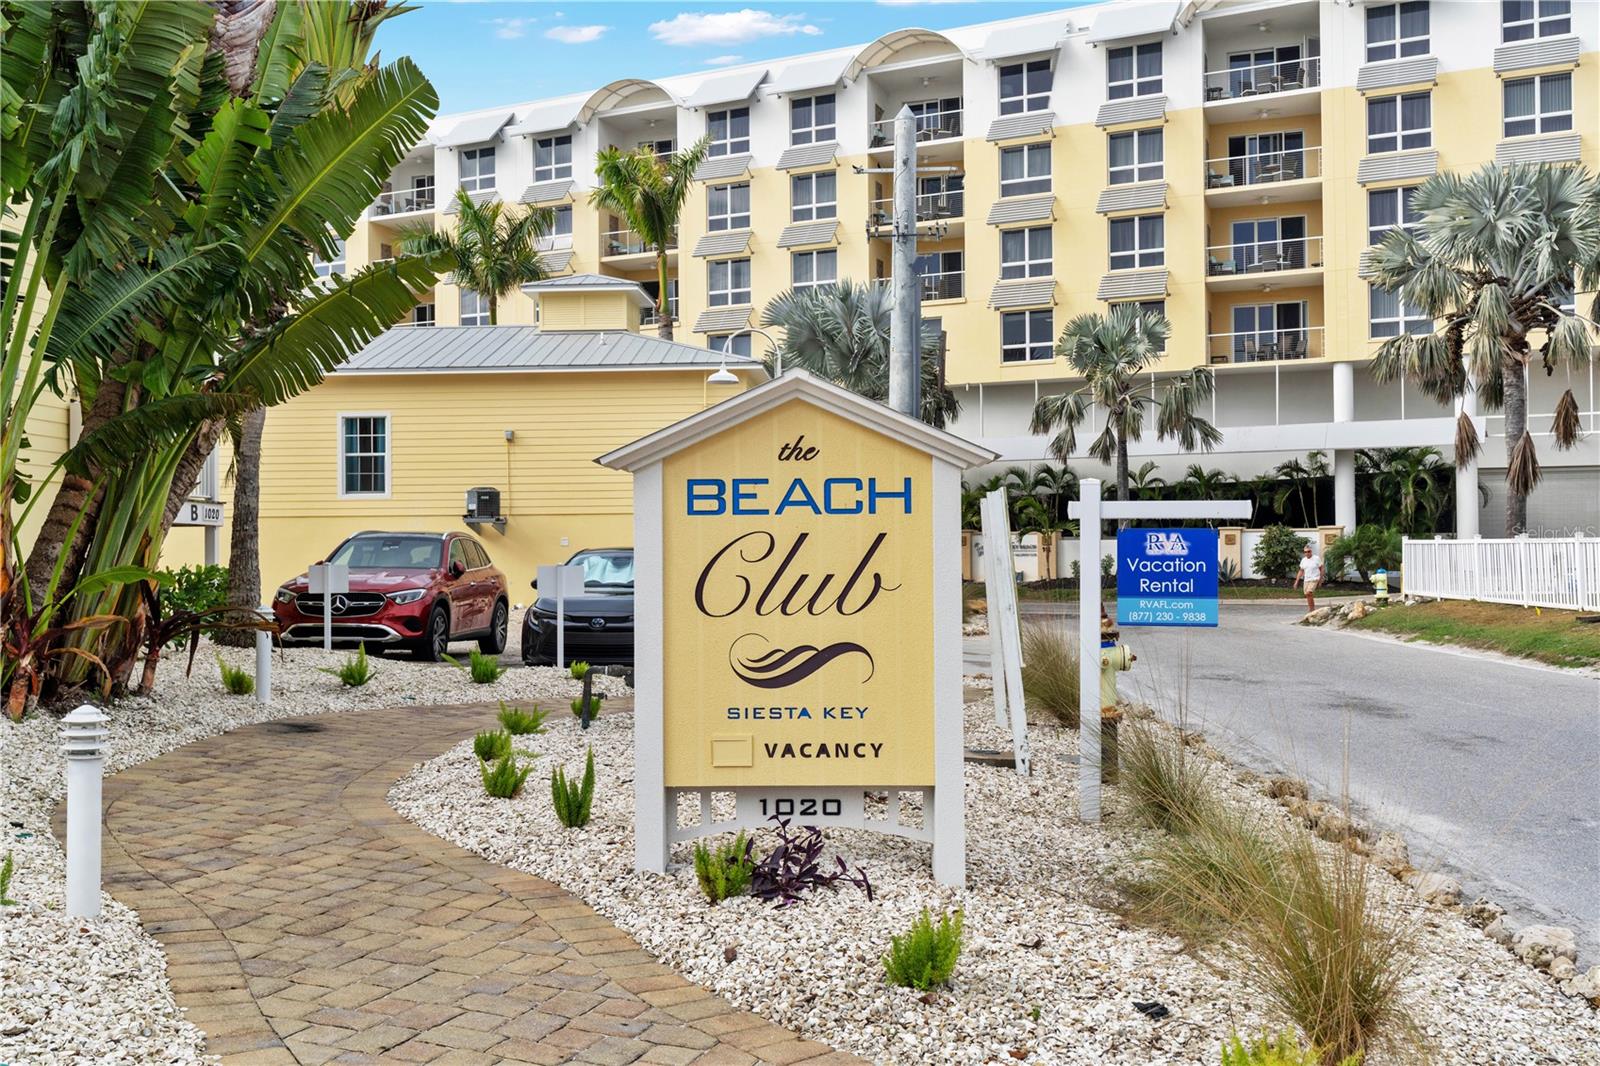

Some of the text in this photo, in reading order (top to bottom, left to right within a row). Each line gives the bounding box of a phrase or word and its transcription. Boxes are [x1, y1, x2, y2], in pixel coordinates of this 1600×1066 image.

[778, 435, 820, 461] the
[686, 477, 912, 516] BEACH
[190, 504, 220, 521] B 1020
[1147, 533, 1188, 553] RVA
[1126, 557, 1207, 573] Vacation
[694, 530, 903, 618] Club
[1139, 578, 1194, 593] Rental
[1139, 600, 1194, 609] RVAFL.com
[1128, 611, 1153, 622] (877)
[1156, 612, 1174, 621] 230
[1182, 612, 1207, 622] 9838
[727, 707, 869, 720] SIESTA KEY
[764, 743, 884, 758] VACANCY
[759, 798, 842, 817] 1020
